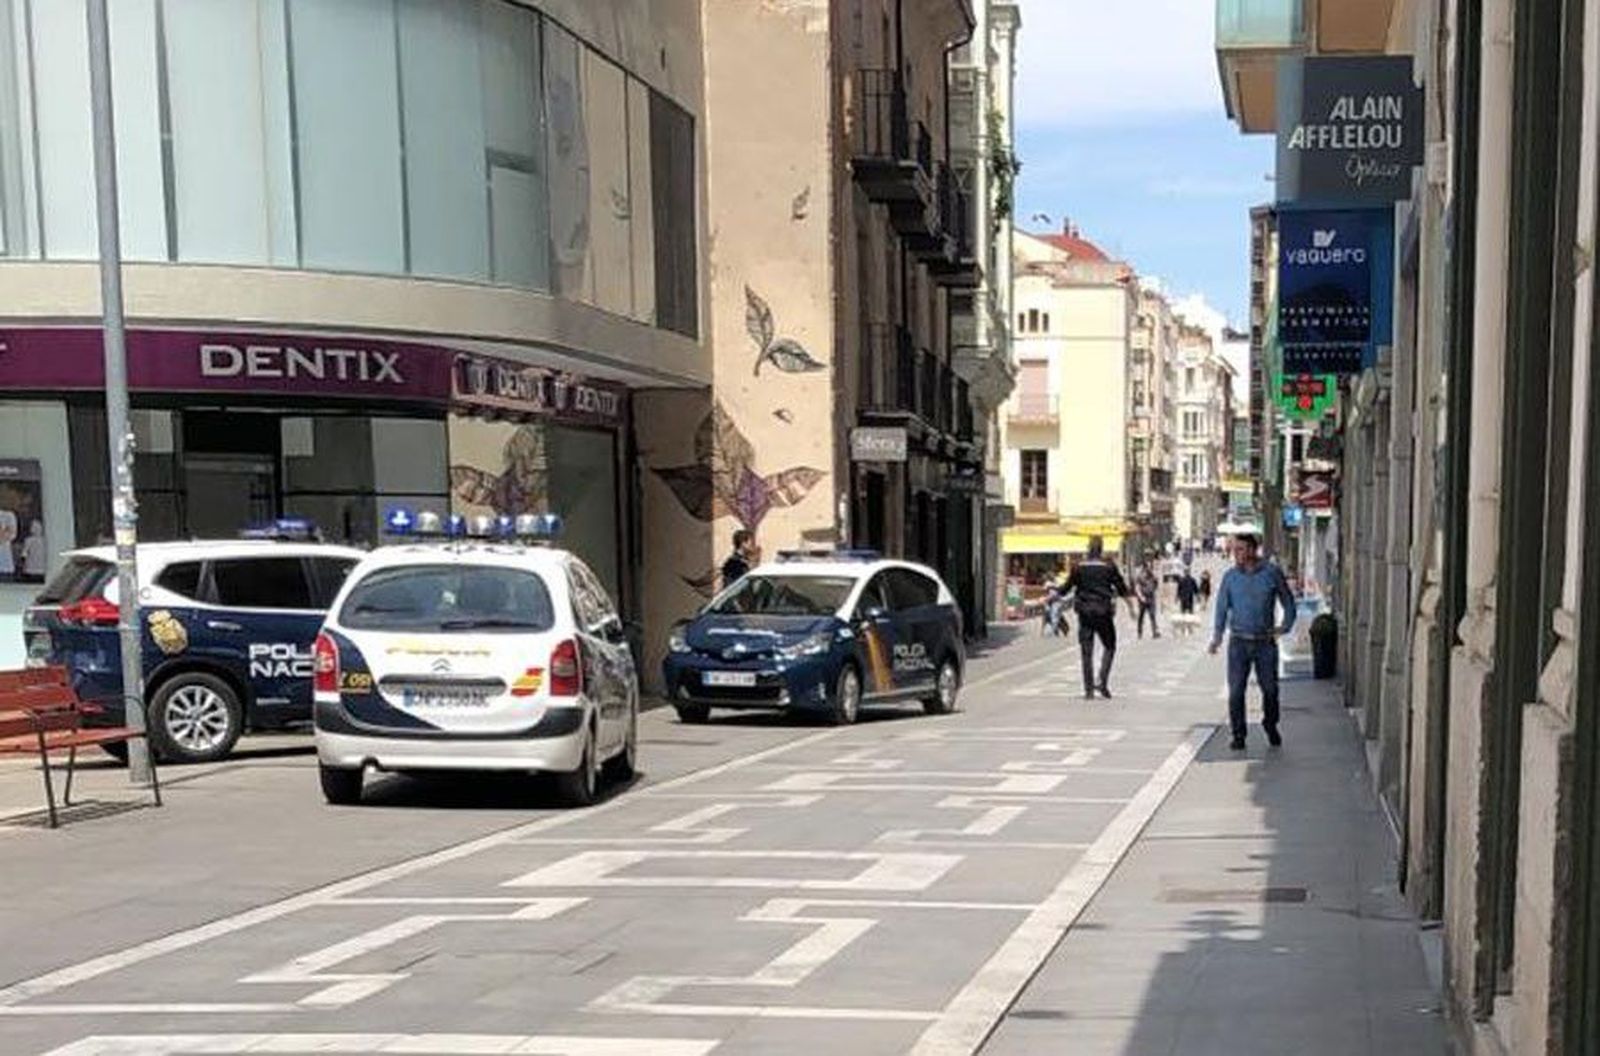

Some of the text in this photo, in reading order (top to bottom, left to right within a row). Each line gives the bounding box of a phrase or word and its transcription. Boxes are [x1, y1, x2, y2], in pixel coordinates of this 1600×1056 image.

[1328, 96, 1402, 121] ALAIN
[1287, 124, 1402, 150] AFFLELOU
[1285, 249, 1366, 265] vaquero
[201, 344, 405, 383] DENTIX
[249, 661, 315, 678] NAC
